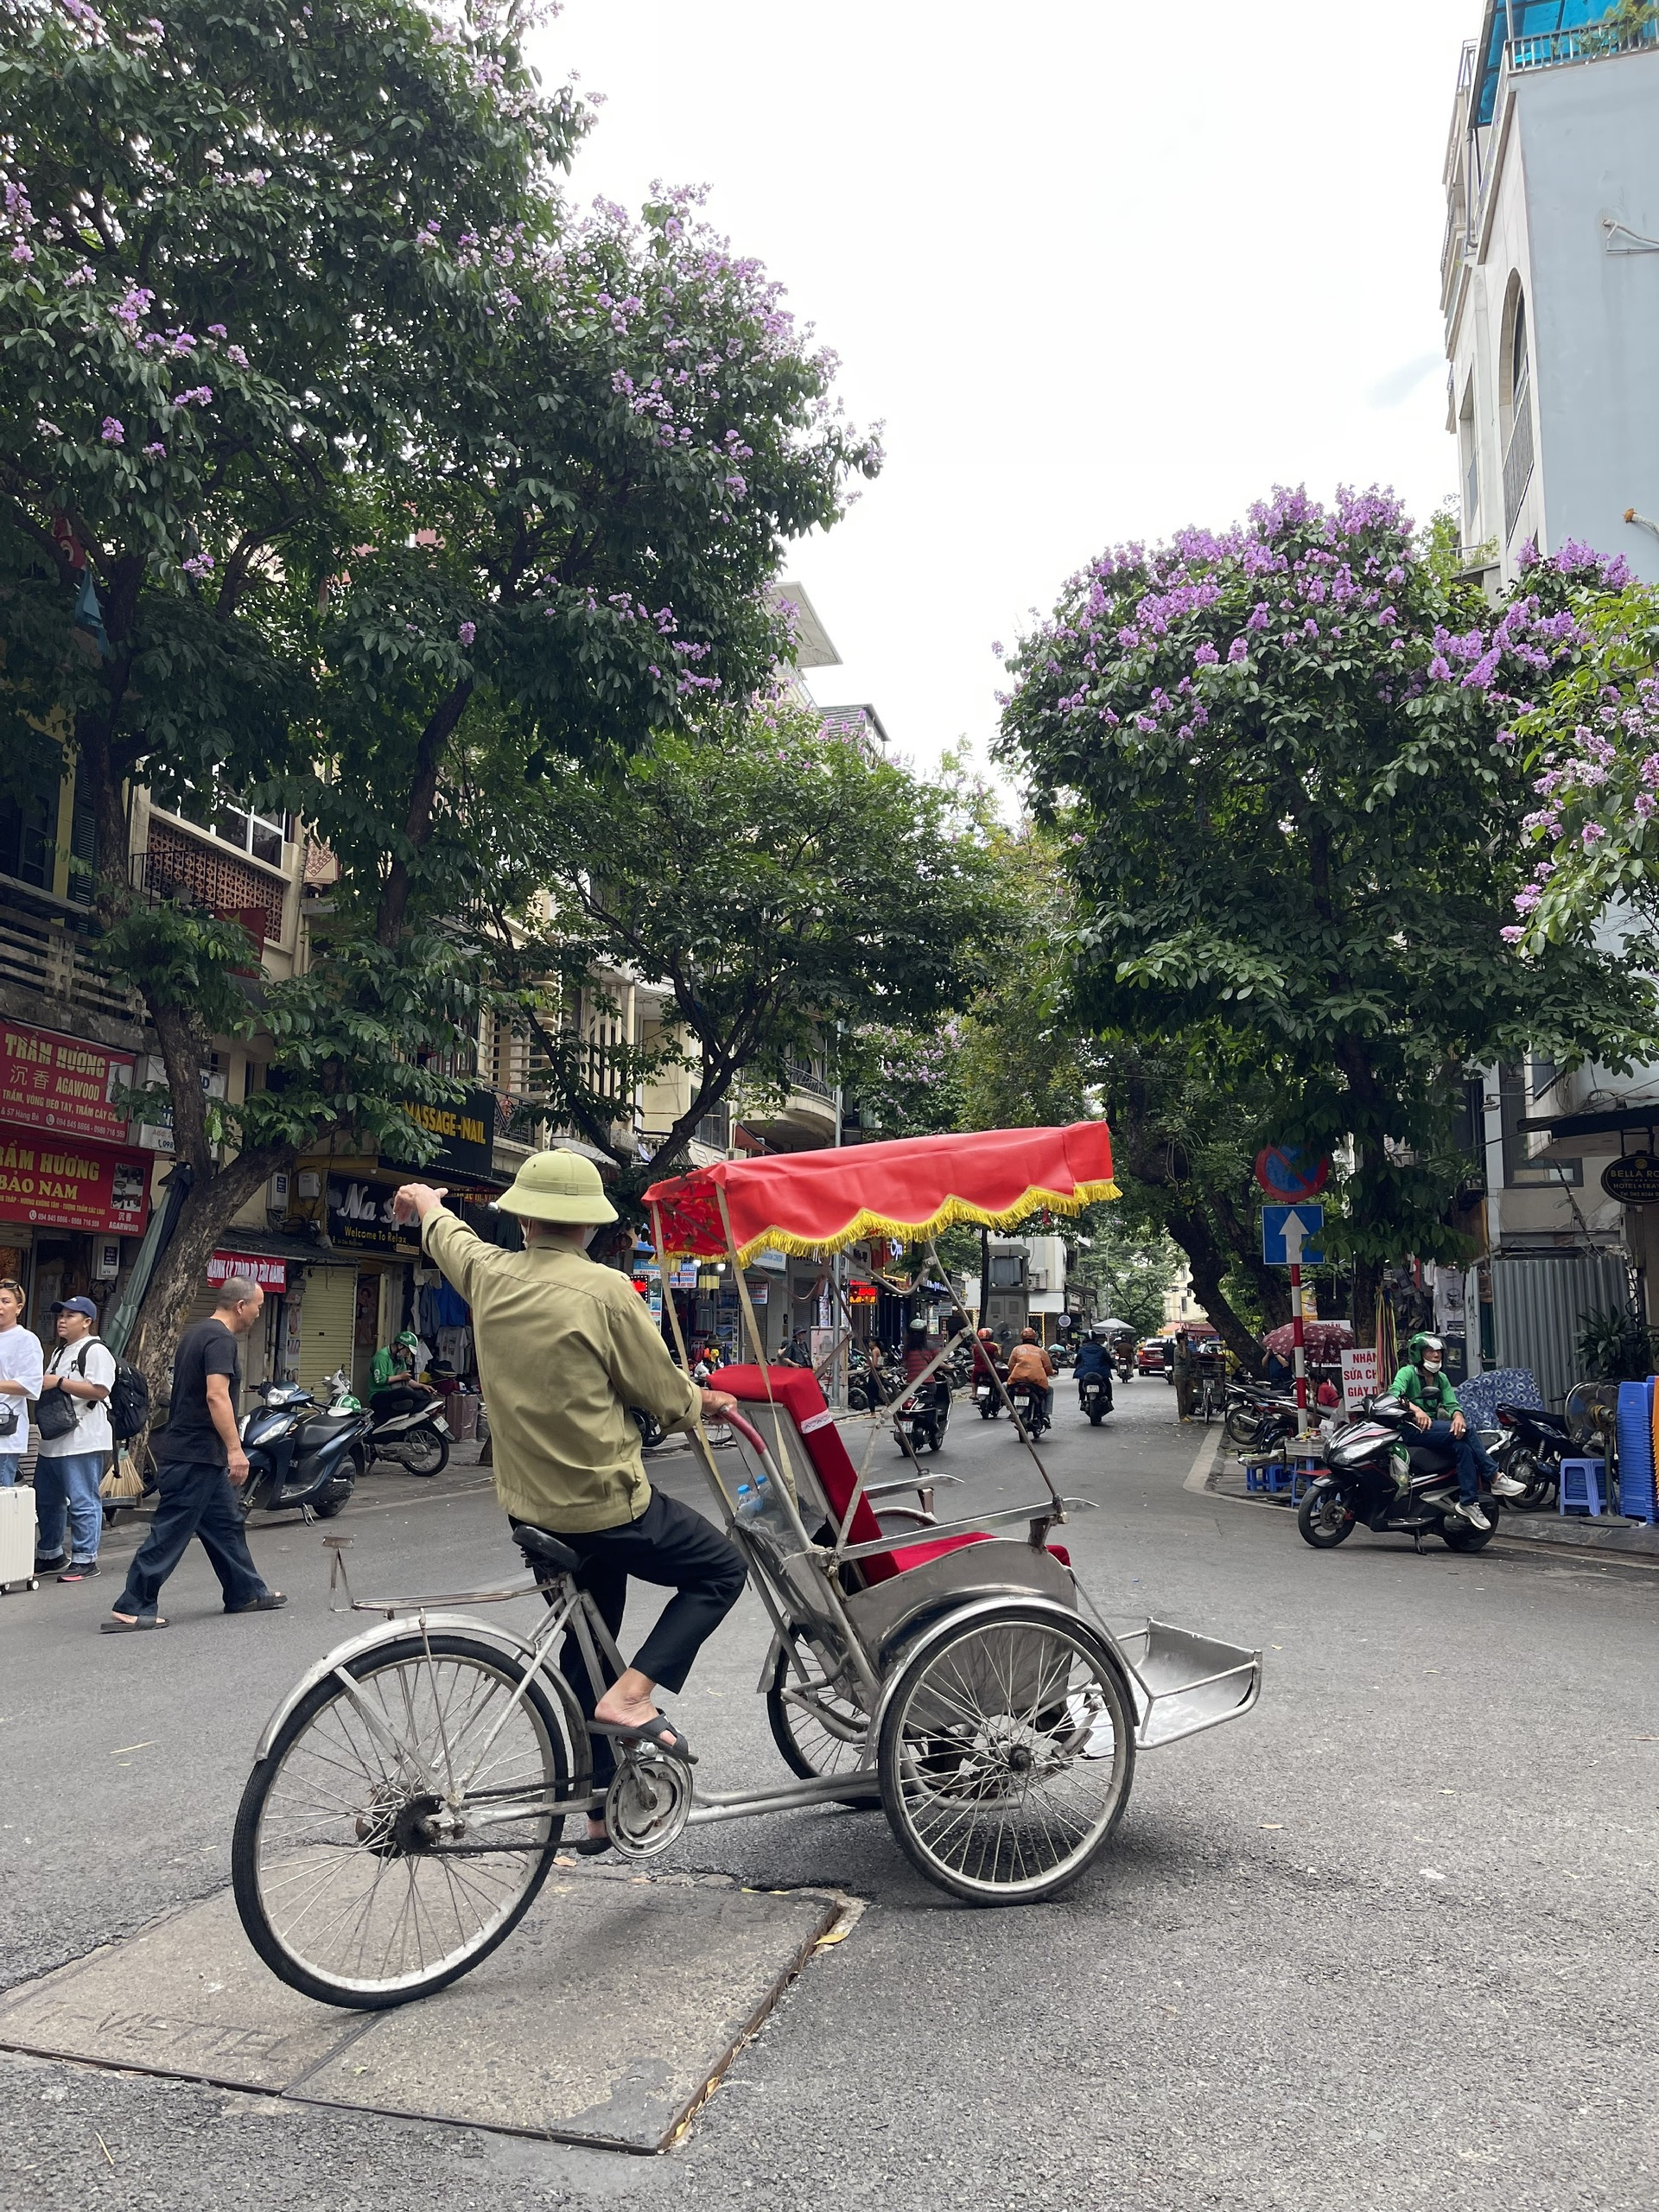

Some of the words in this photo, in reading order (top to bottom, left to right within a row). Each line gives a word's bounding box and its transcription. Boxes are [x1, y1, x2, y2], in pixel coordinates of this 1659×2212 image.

[56, 1045, 105, 1078] HƯƠNG
[10, 1064, 50, 1090] 沉香
[55, 1076, 100, 1102] AGAWOOD
[40, 1152, 100, 1181] HƯƠNG
[1610, 1169, 1643, 1178] BELLA
[0, 1170, 35, 1193] BẢO
[38, 1179, 79, 1200] NAM
[336, 1183, 377, 1221] Na
[108, 1221, 139, 1233] AGARWOOD
[345, 1225, 377, 1240] Welcome
[378, 1230, 386, 1242] To
[387, 1231, 407, 1244] Relax
[207, 1258, 226, 1279] HANH
[1344, 1367, 1363, 1381] SỬA
[1348, 1384, 1369, 1397] GIÀY
